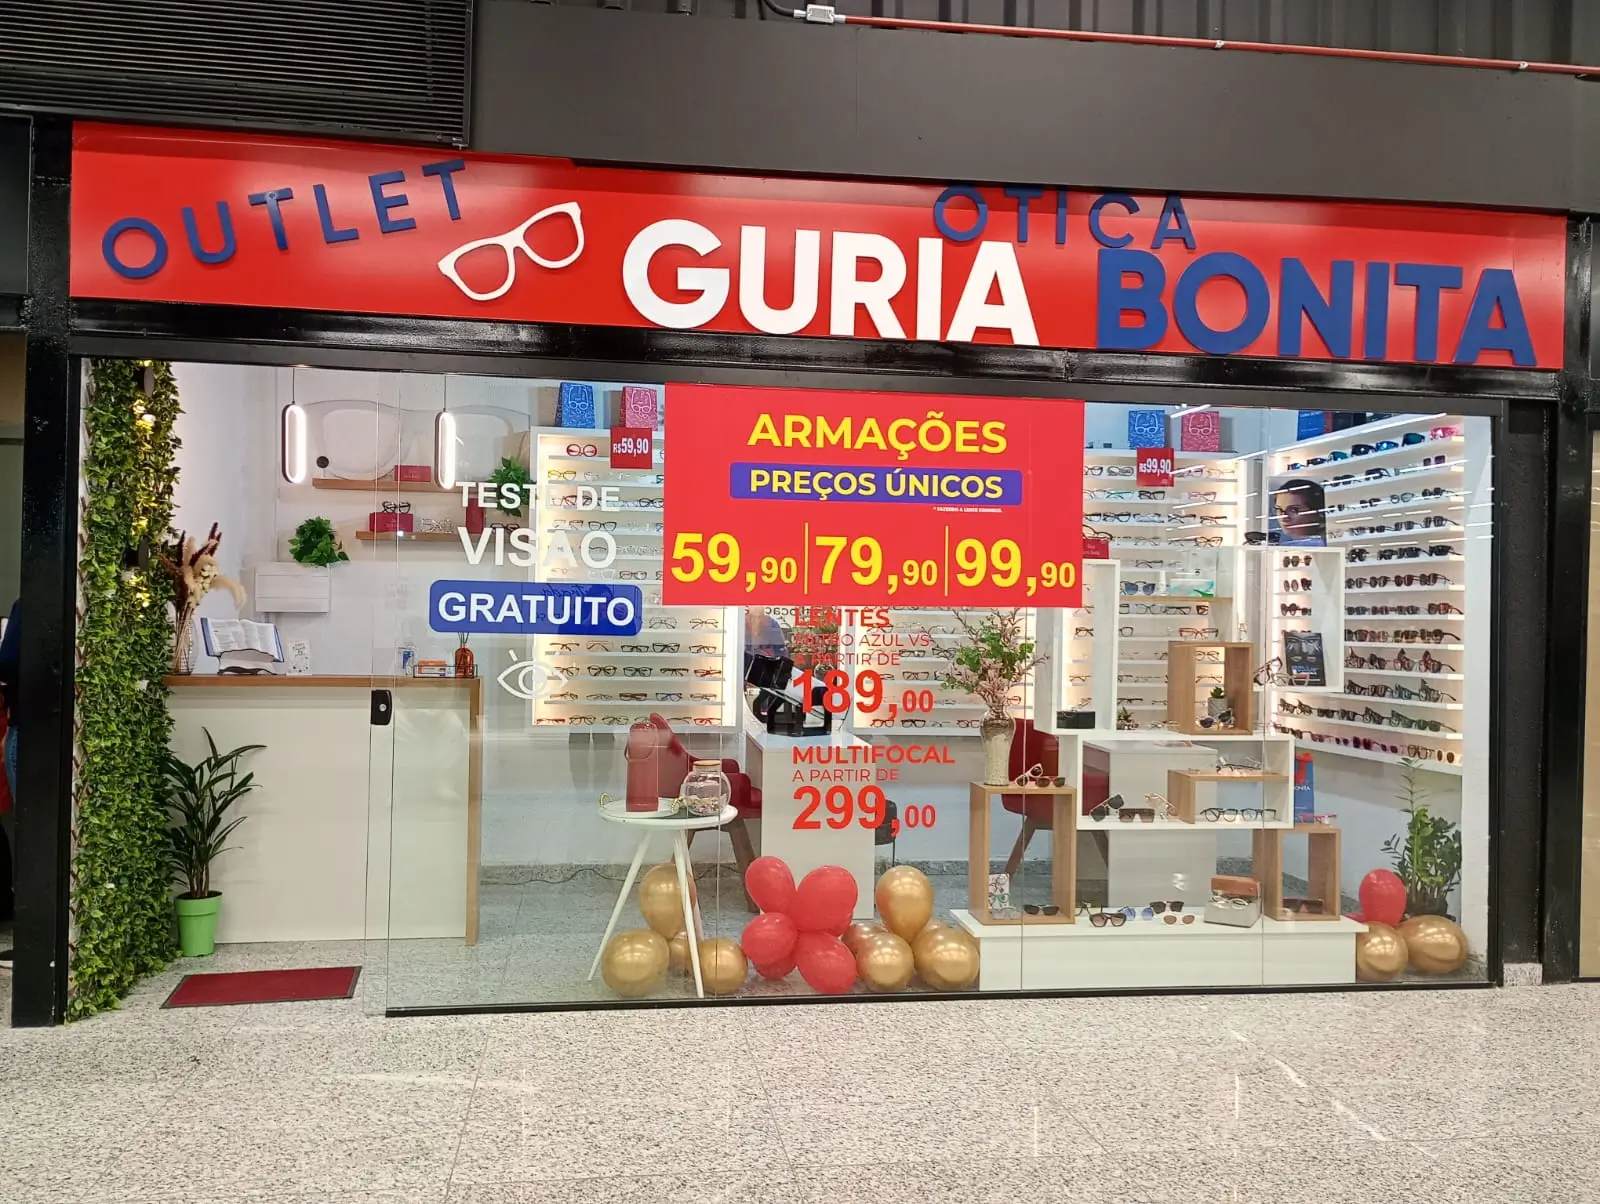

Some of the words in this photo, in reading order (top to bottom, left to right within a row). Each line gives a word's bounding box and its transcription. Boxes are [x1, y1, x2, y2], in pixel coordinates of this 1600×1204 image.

[101, 159, 467, 279] OUTLET
[622, 218, 1040, 347] GURIA
[1097, 246, 1537, 367] BONITA
[612, 437, 649, 457] R$59,90
[747, 411, 1008, 460] ARMAÇÕES
[1138, 458, 1171, 477] R$99,90
[456, 482, 565, 510] TESTE
[576, 485, 621, 512] DE
[750, 468, 876, 501] PREÇOS
[885, 468, 1003, 499] ÚNICOS
[671, 532, 797, 592] 59,90
[815, 536, 938, 594] 79,90
[955, 538, 1076, 596] 99,90
[438, 592, 635, 627] GRATUITO
[794, 607, 890, 628] LENTES
[859, 634, 904, 647] AZUL
[908, 634, 930, 647] VS
[811, 652, 872, 666] PARTIR
[877, 653, 900, 666] DE
[792, 669, 934, 720] 189,00
[792, 744, 956, 765] MULTIFOCAL
[792, 769, 805, 782] A
[810, 768, 871, 782] PARTIR
[876, 768, 899, 781] DE
[792, 784, 936, 837] 299,00
